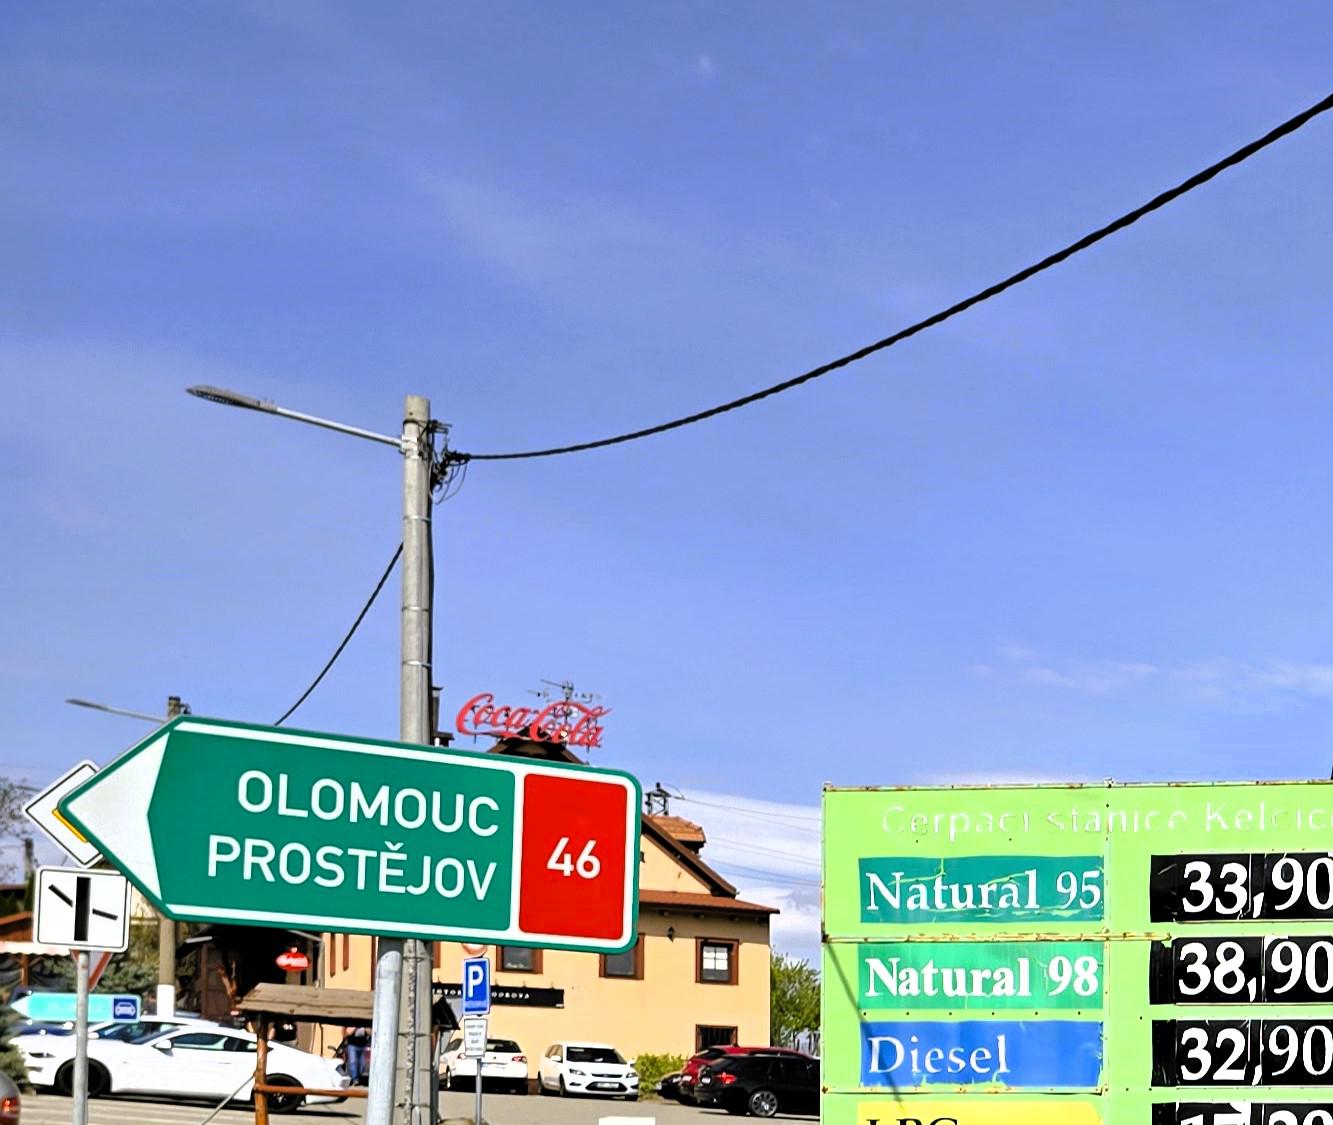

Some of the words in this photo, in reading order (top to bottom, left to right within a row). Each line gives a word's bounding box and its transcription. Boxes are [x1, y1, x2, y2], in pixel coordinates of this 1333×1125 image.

[238, 769, 499, 836] OLOMOUC
[208, 834, 497, 900] PROSTĚJOV
[547, 837, 600, 879] 46
[866, 869, 1039, 911] Natural
[1056, 870, 1101, 910] 95
[467, 965, 484, 998] P
[865, 956, 1032, 997] Natural
[1049, 955, 1098, 997] 98
[867, 1034, 1011, 1075] Diesel
